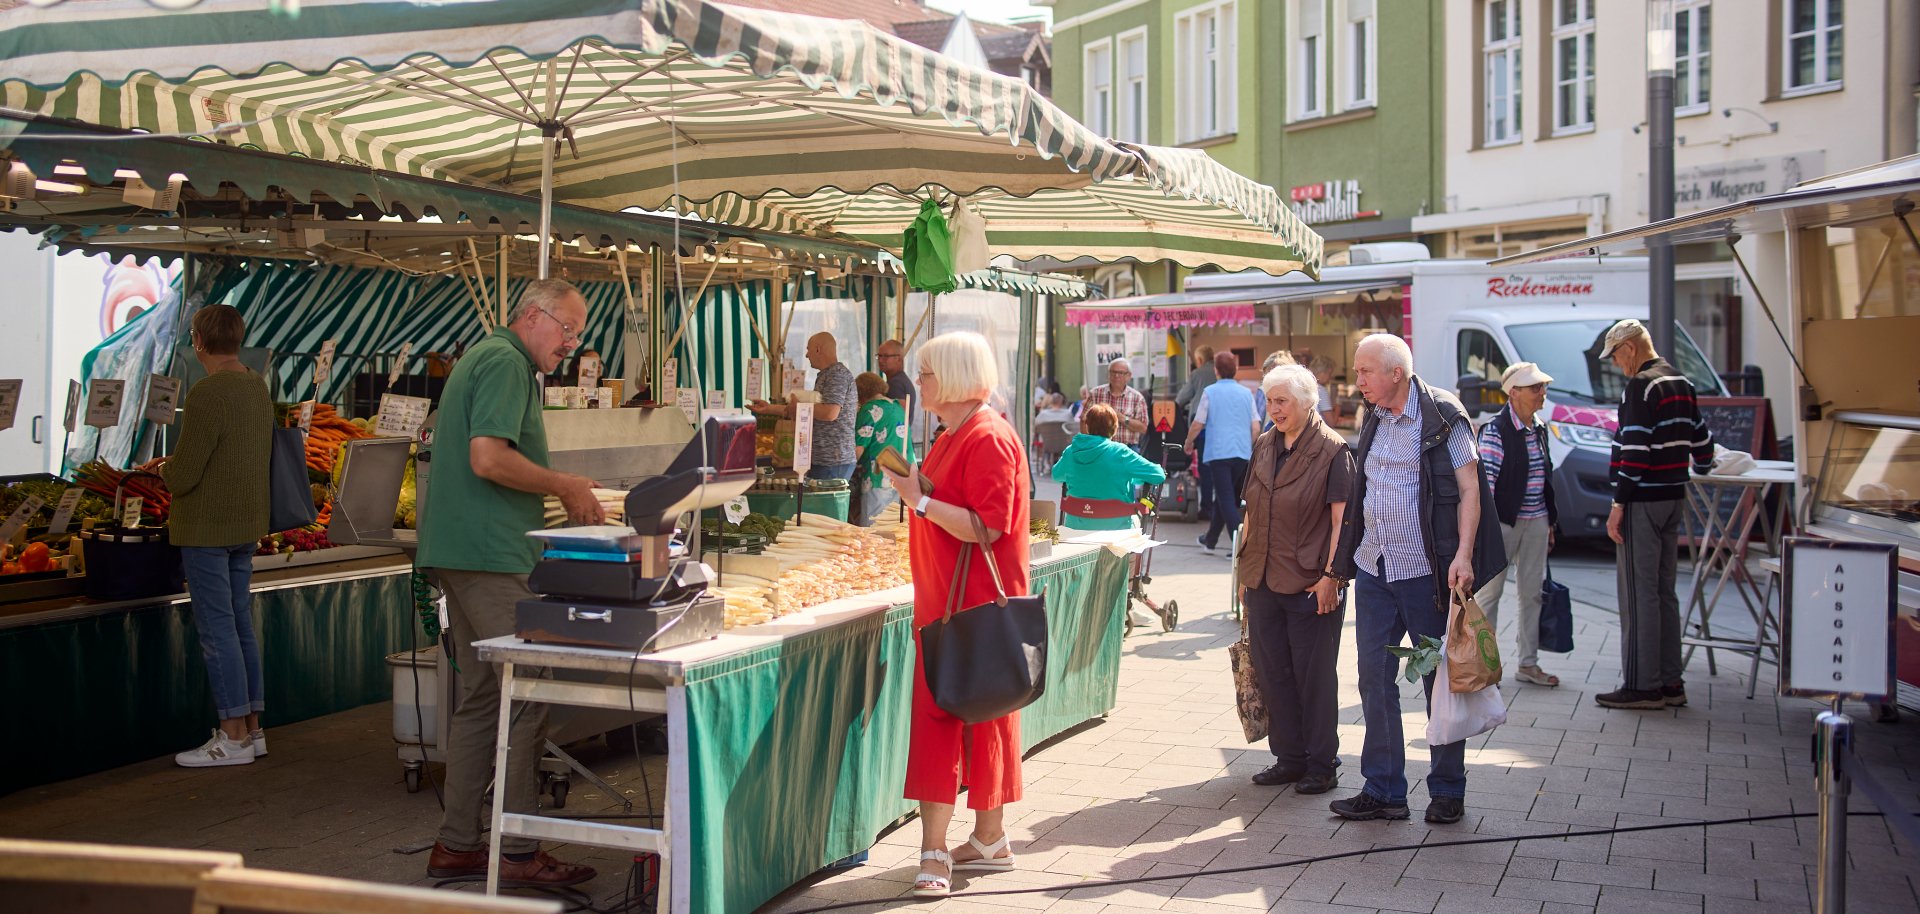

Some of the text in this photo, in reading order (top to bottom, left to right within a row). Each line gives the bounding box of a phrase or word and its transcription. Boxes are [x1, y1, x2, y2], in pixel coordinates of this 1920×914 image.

[1707, 180, 1766, 202] Magera
[1487, 277, 1593, 298] Reckermann
[1833, 563, 1844, 681] AUSGANG
